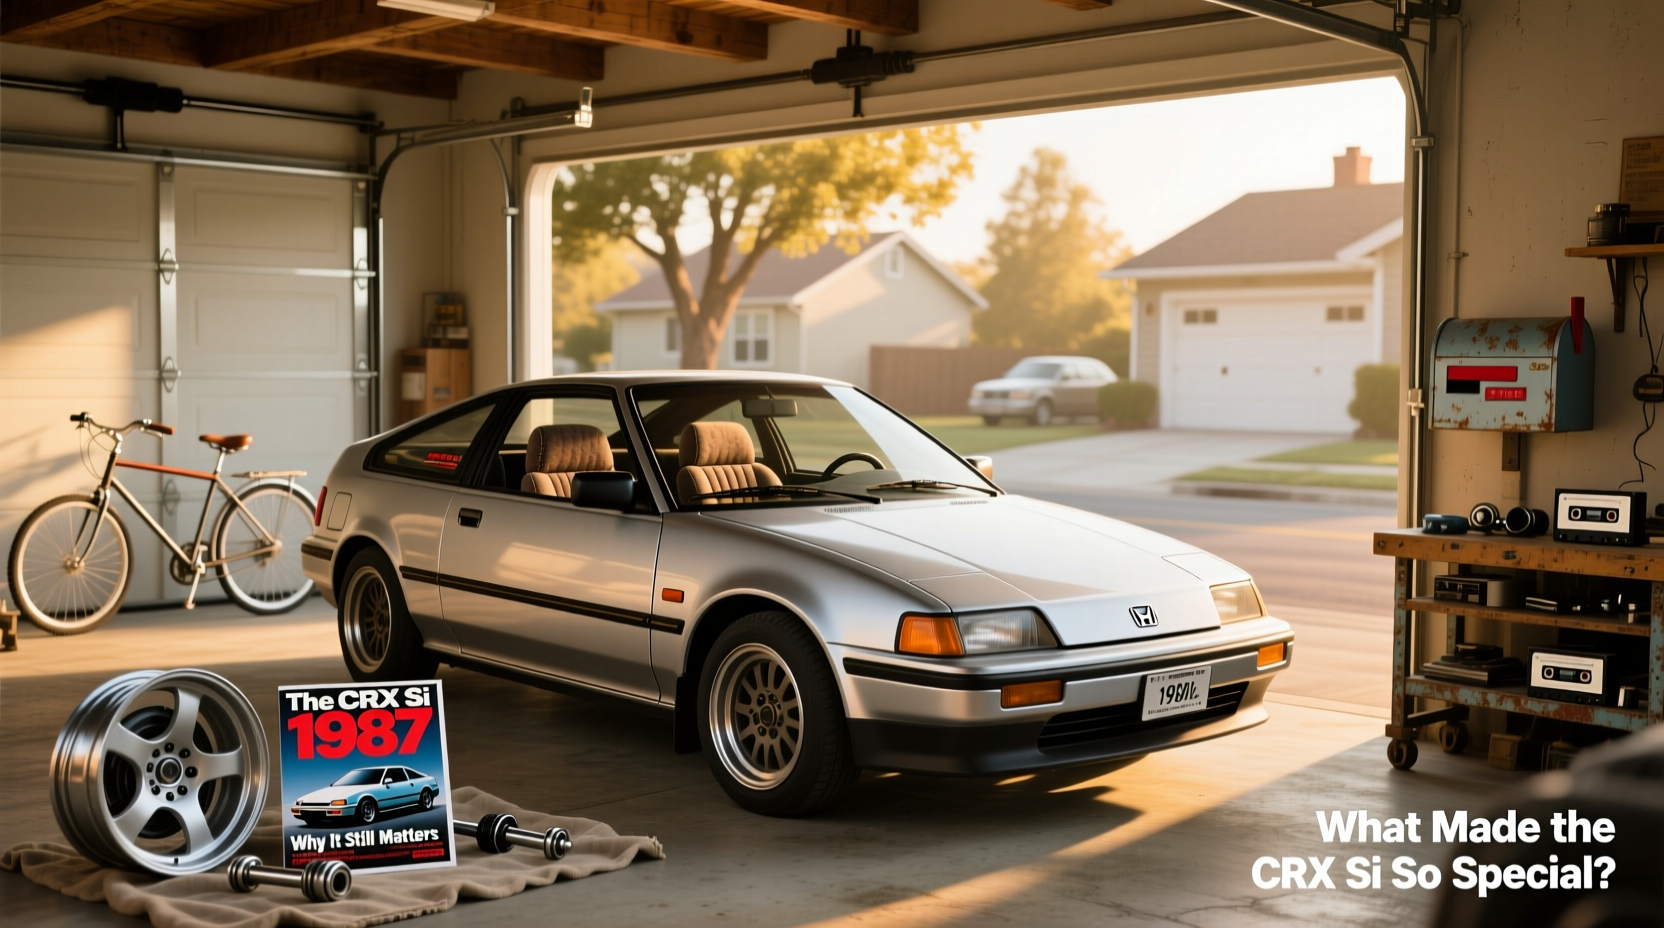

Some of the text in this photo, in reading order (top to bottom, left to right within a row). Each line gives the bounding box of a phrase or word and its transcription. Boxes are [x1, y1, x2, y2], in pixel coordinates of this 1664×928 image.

[286, 687, 430, 711] The CRX Si
[287, 707, 433, 760] 1987
[290, 834, 326, 853] Why
[345, 830, 374, 847] Still
[379, 828, 439, 845] Matters
